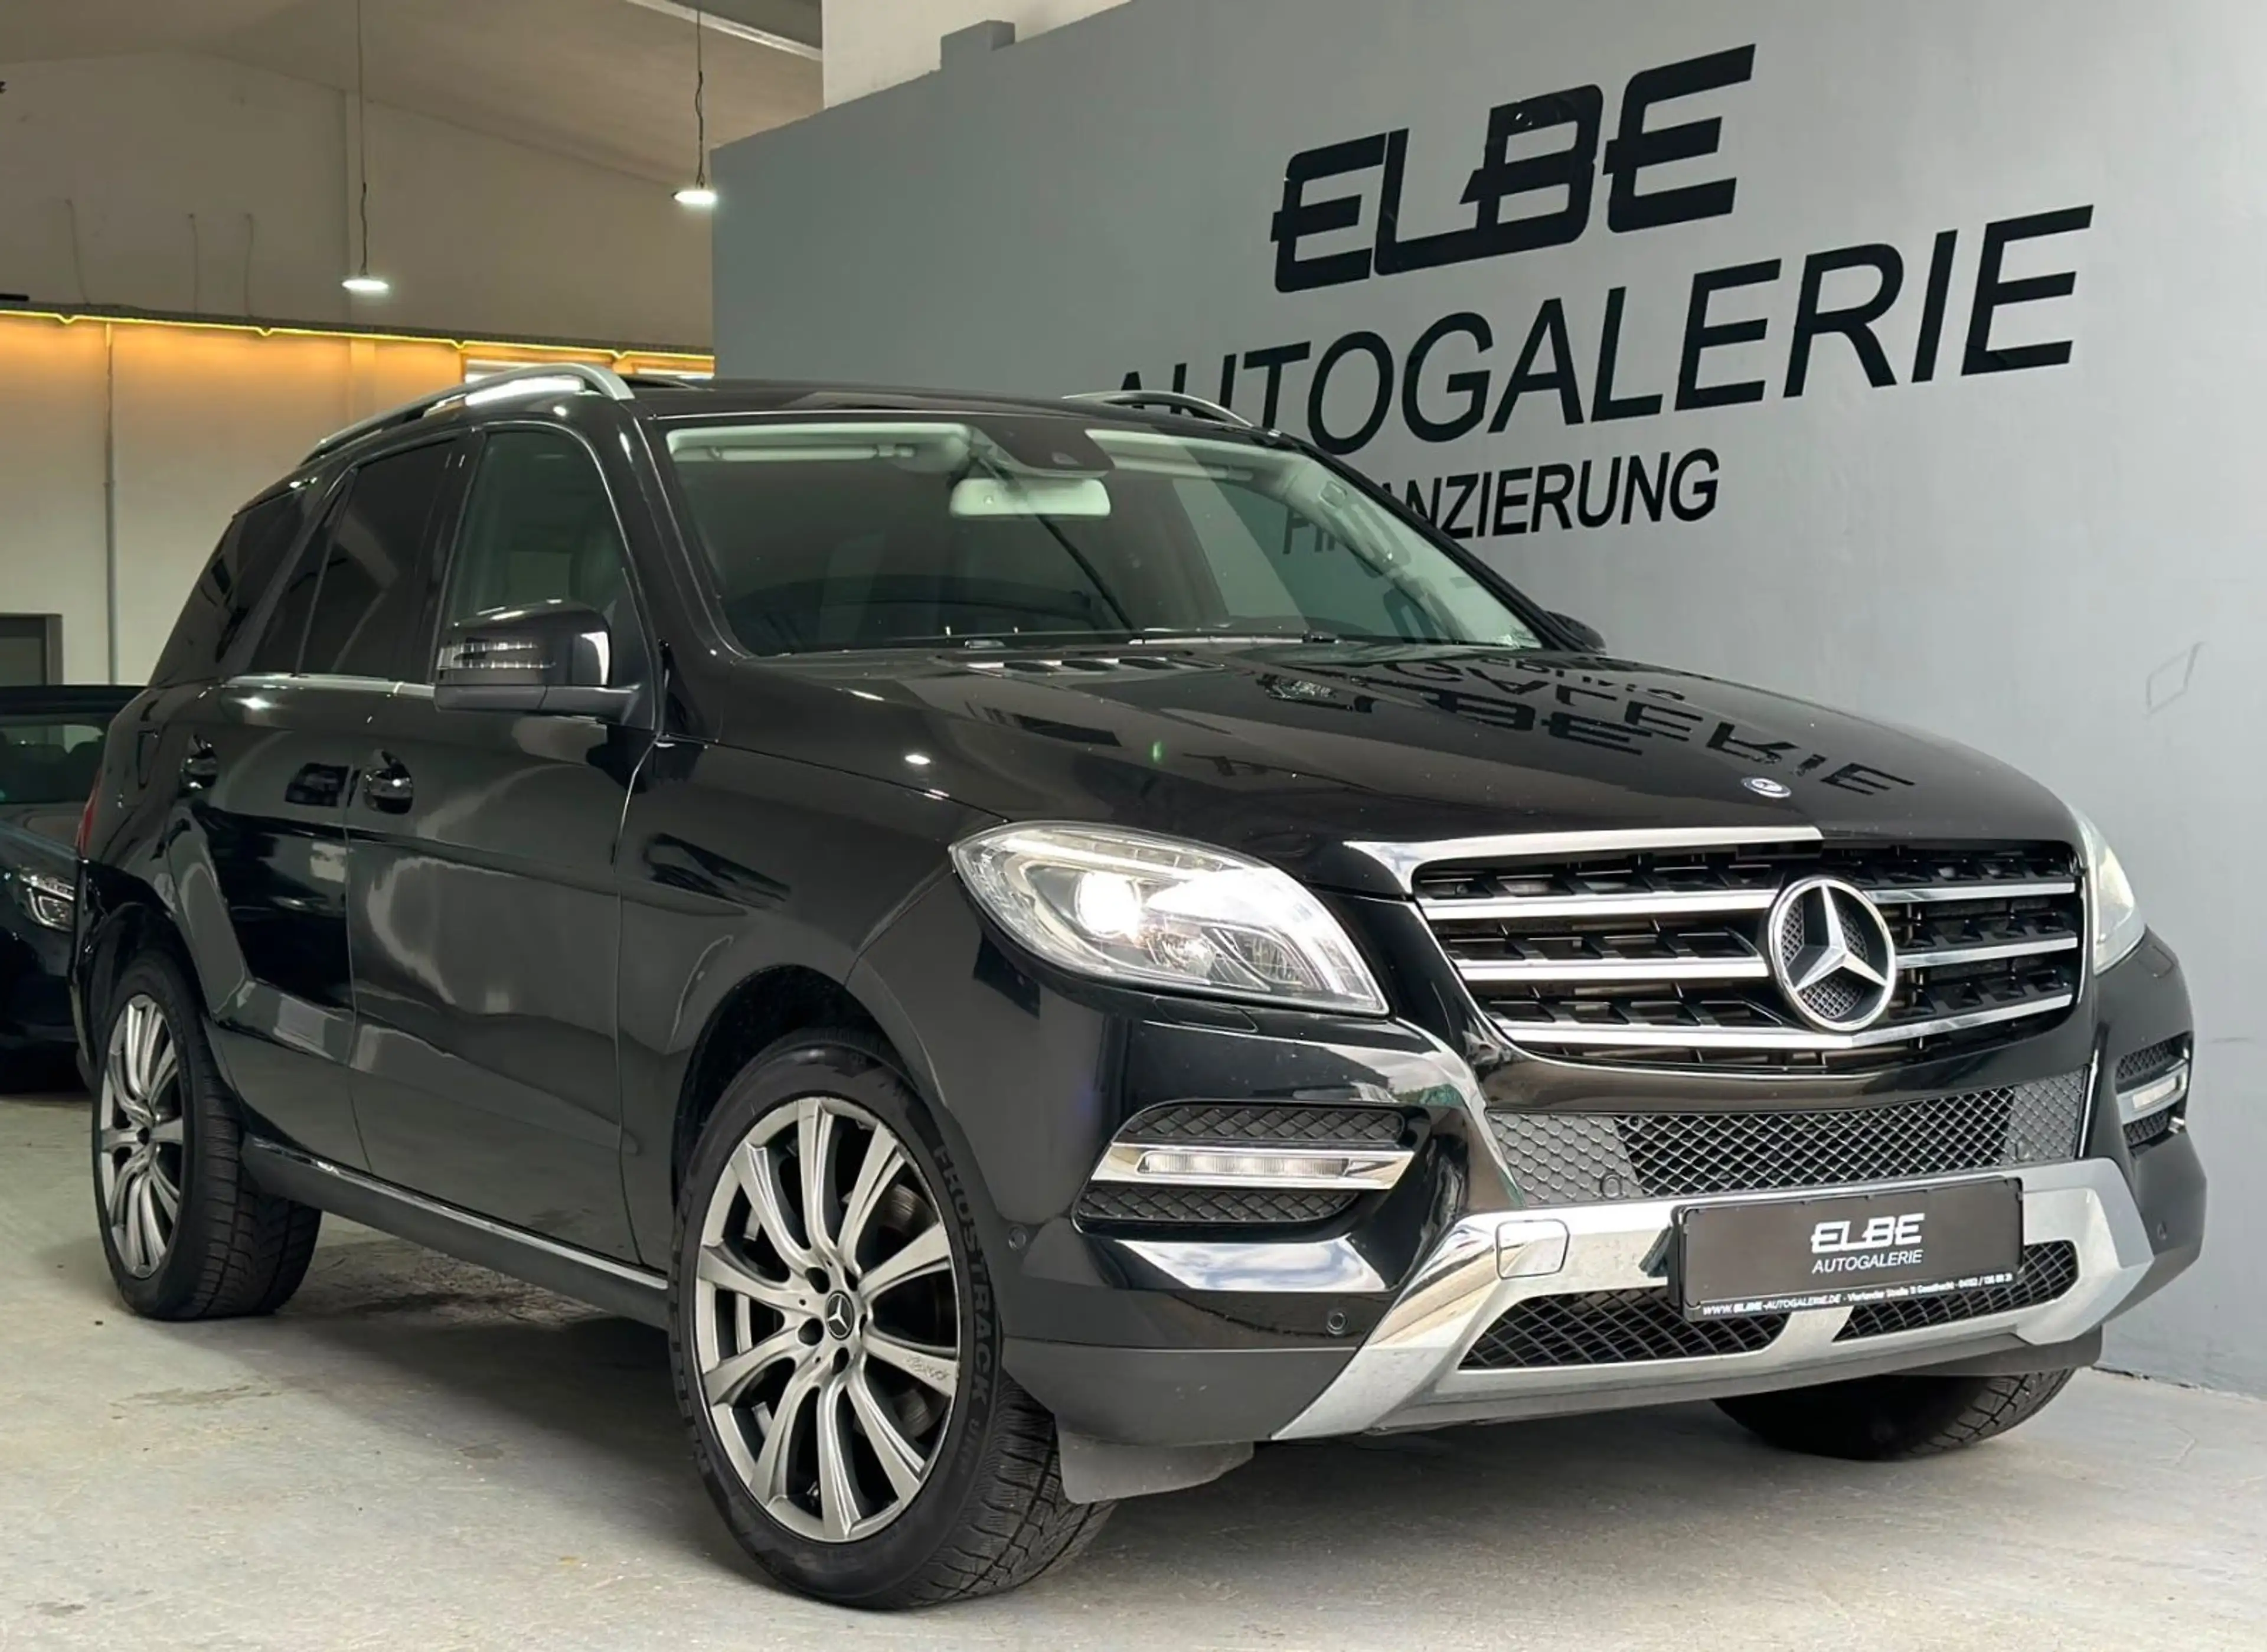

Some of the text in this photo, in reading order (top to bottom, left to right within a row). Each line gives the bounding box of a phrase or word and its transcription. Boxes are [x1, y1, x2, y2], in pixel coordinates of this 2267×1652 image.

[1270, 44, 1755, 293] ELBE
[1121, 205, 2093, 455] TOGALERIE
[1282, 448, 1719, 554] FNZIERUNG
[934, 1145, 993, 1406] FROSTRACK
[1811, 1213, 1925, 1253] ELBE
[1812, 1249, 1924, 1274] AUTOGALERIE
